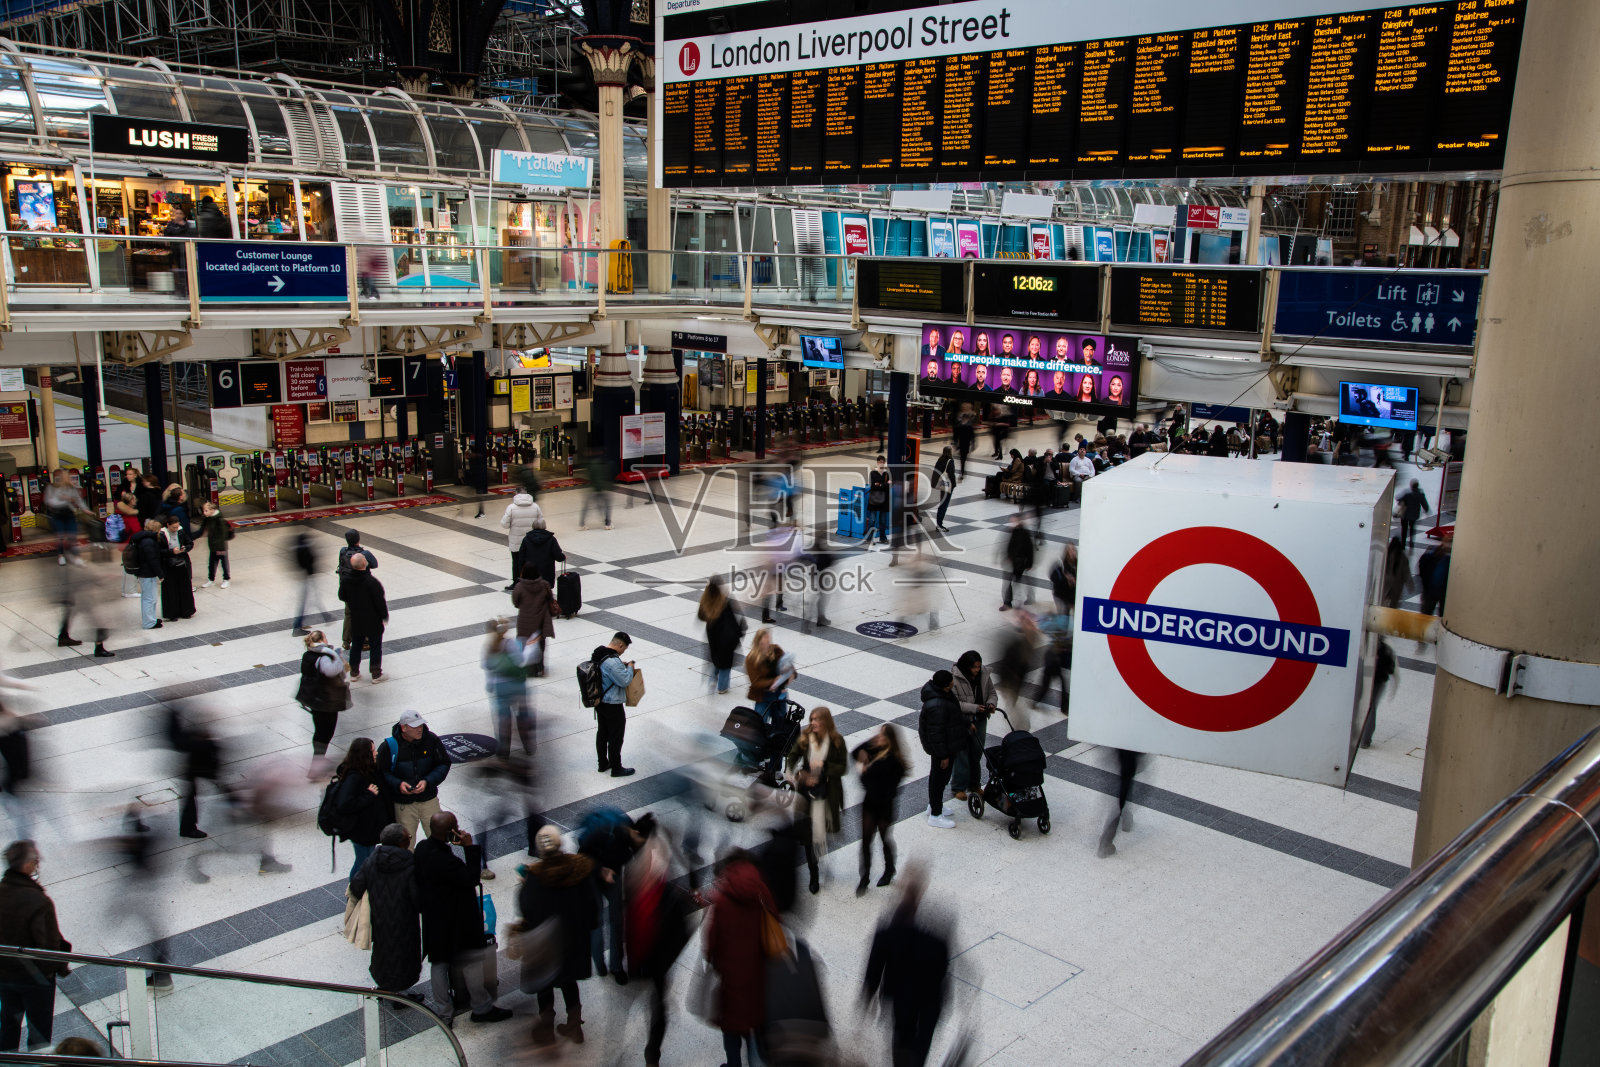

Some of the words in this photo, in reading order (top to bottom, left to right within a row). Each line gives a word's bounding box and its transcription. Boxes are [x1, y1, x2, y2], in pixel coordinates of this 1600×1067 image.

[667, 0, 700, 10] Departures
[1409, 7, 1437, 16] Platform
[1455, 12, 1489, 22] Braintree
[1316, 17, 1332, 26] 12:45
[1339, 15, 1365, 23] Platform
[1382, 19, 1414, 29] Chingford
[1253, 24, 1268, 32] 12:42
[1274, 22, 1298, 30] Platform
[1314, 27, 1341, 36] Cheshunt
[711, 38, 790, 68] London
[798, 17, 913, 60] Liverpool
[920, 8, 1010, 46] Street
[1251, 33, 1276, 42] Hertford
[1279, 32, 1292, 40] East
[1192, 40, 1216, 48] Stansted
[1218, 38, 1237, 46] Airport
[128, 128, 190, 149] LUSH
[192, 134, 218, 142] FRESH
[1222, 210, 1232, 219] Free
[236, 250, 279, 260] Customer
[281, 251, 312, 261] Lounge
[206, 262, 239, 271] located
[241, 263, 279, 273] adjacent
[293, 263, 328, 272] Platform
[1377, 285, 1407, 300] Lift
[1326, 310, 1381, 328] Toilets
[970, 355, 1000, 366] people
[1002, 357, 1027, 368] make
[1029, 359, 1044, 369] the
[1046, 360, 1102, 374] difference.
[409, 361, 422, 380] 7
[219, 369, 233, 388] 6
[449, 374, 454, 385] 7
[319, 379, 324, 391] 6
[1003, 395, 1033, 405] JCDecaux
[1098, 605, 1330, 656] UNDERGROUND
